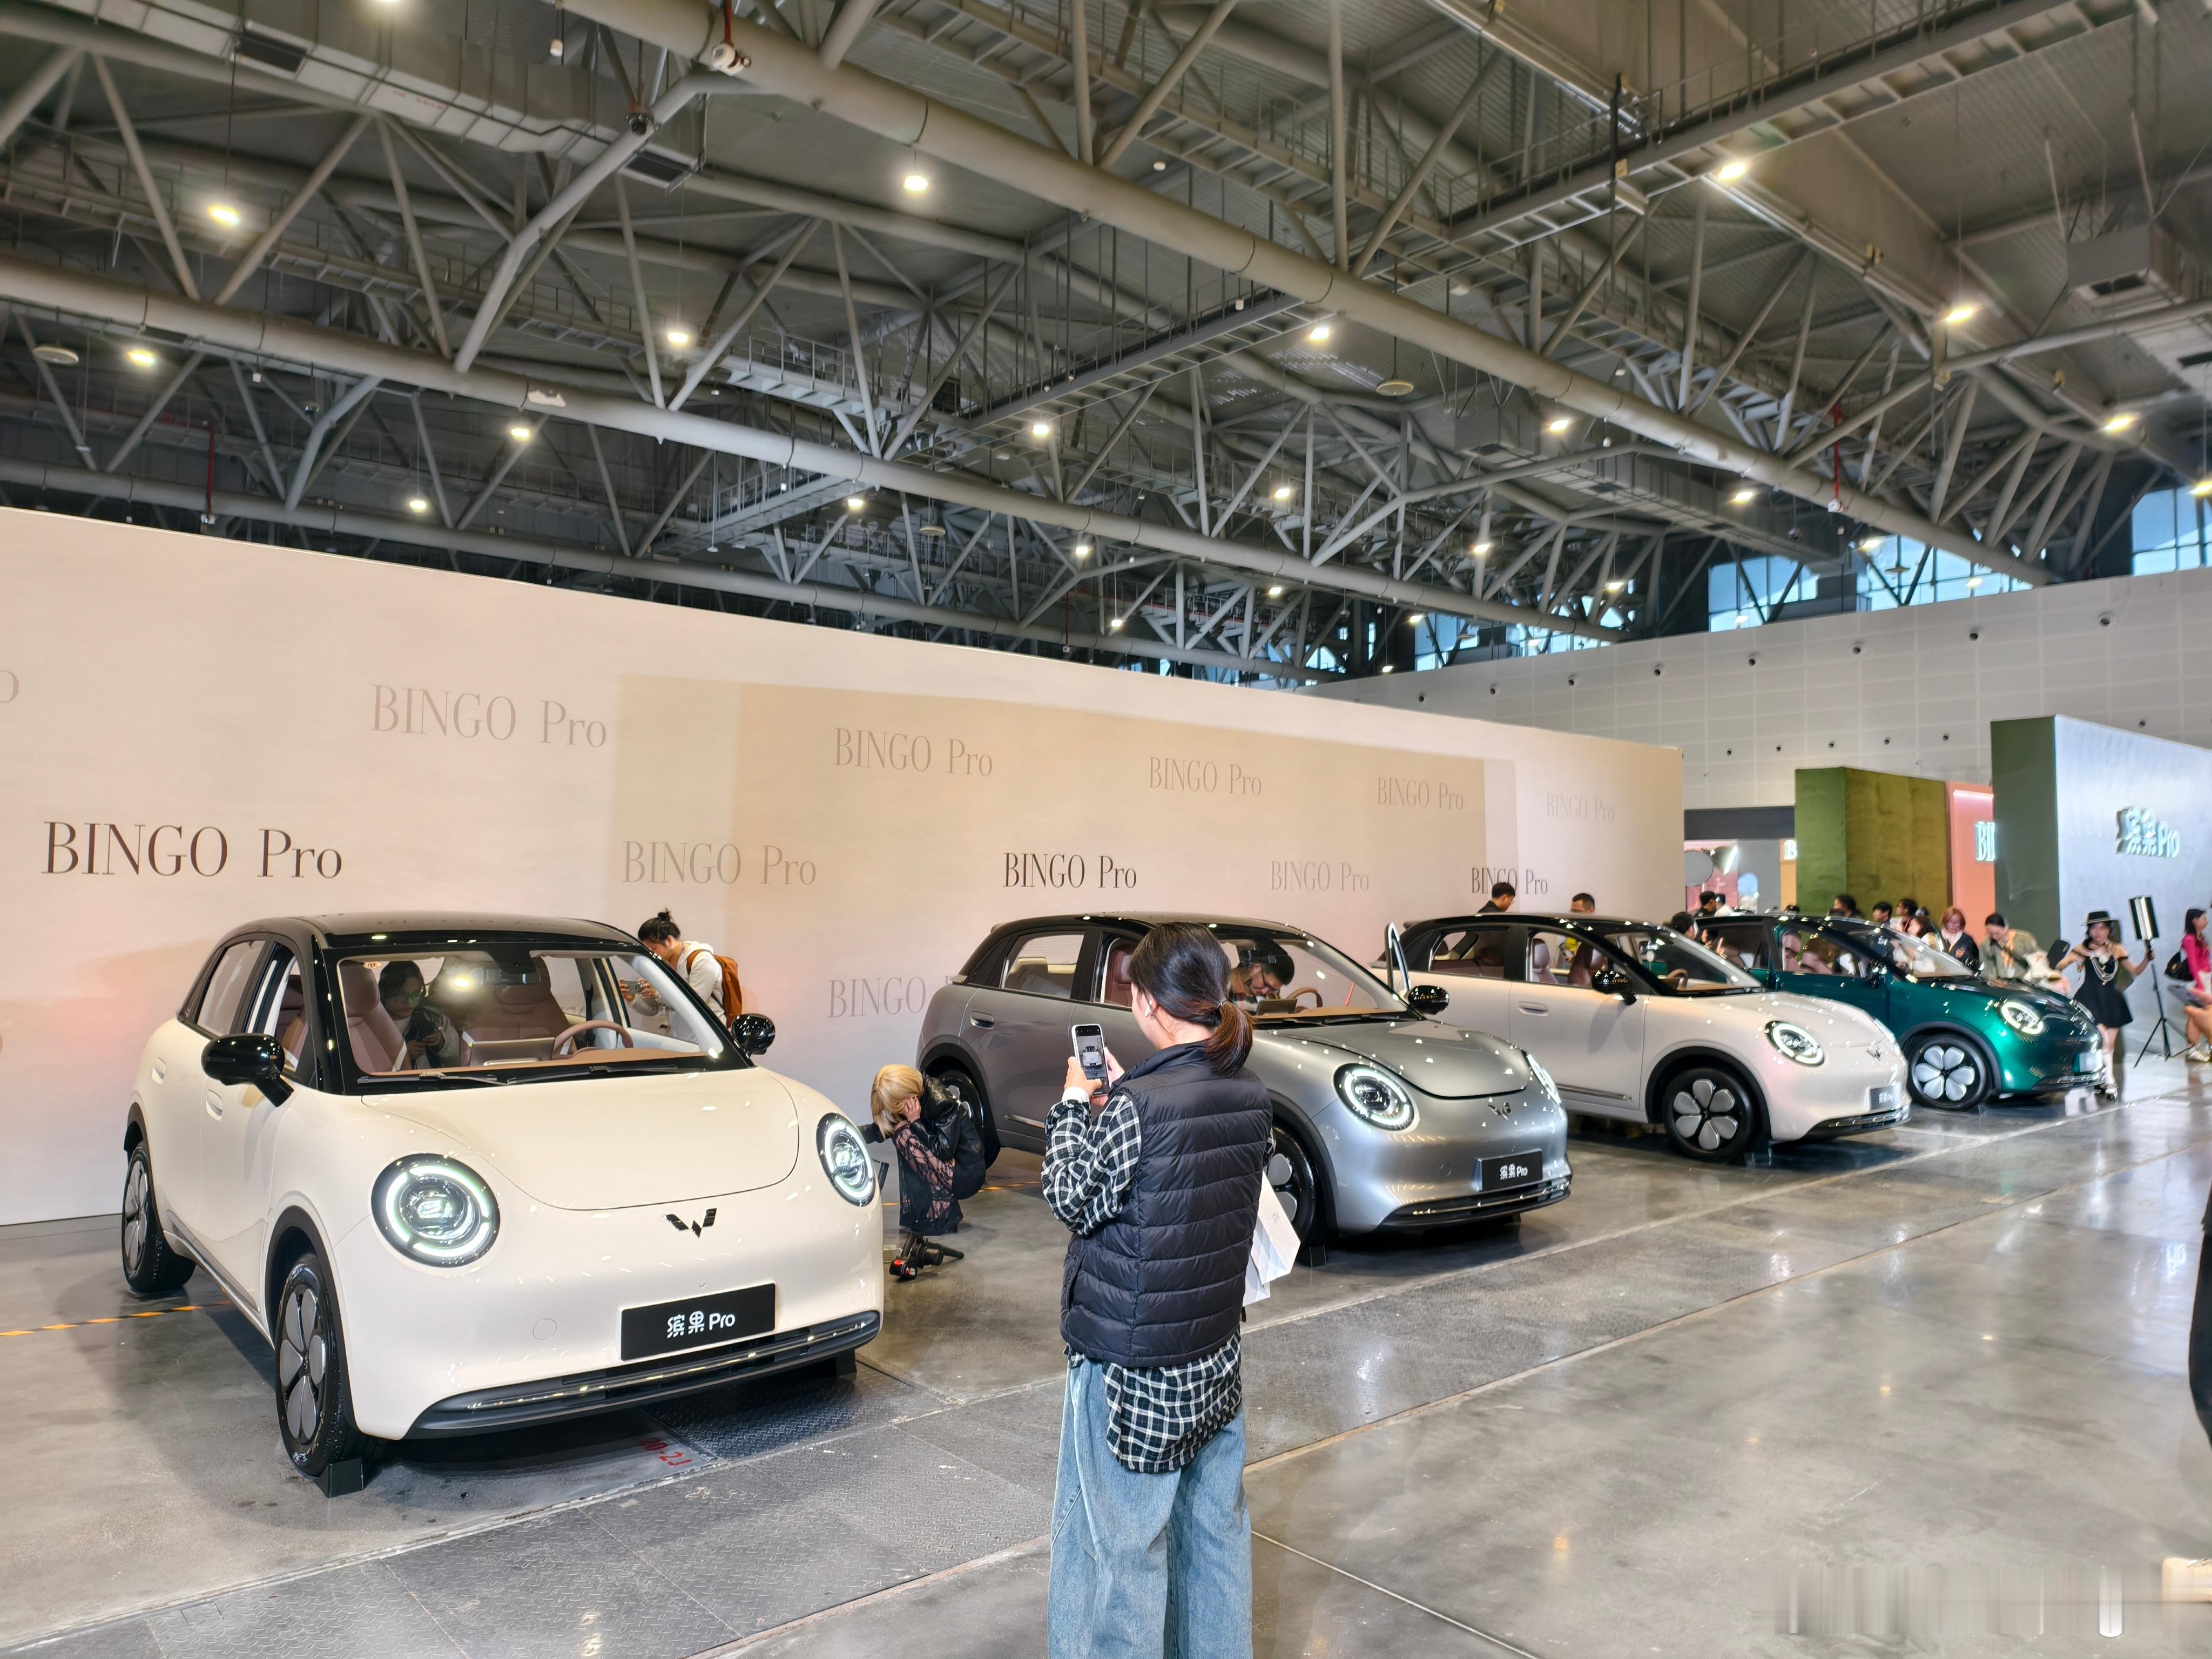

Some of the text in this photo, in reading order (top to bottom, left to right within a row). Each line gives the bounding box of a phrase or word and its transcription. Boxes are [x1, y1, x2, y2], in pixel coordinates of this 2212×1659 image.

[370, 684, 607, 748] BINGO Pro
[834, 727, 993, 777] BINGO Pro
[1149, 757, 1262, 797] BINGO Pro
[1377, 777, 1464, 811] BINGO Pro
[1547, 792, 1615, 822] BINGO Pro
[42, 821, 342, 879] BINGO Pro
[622, 841, 817, 886] BINGO Pro
[1003, 852, 1137, 889] BINGO Pro
[1271, 861, 1369, 892] BINGO Pro
[1526, 869, 1548, 895] Pro
[827, 976, 926, 1018] BINGO
